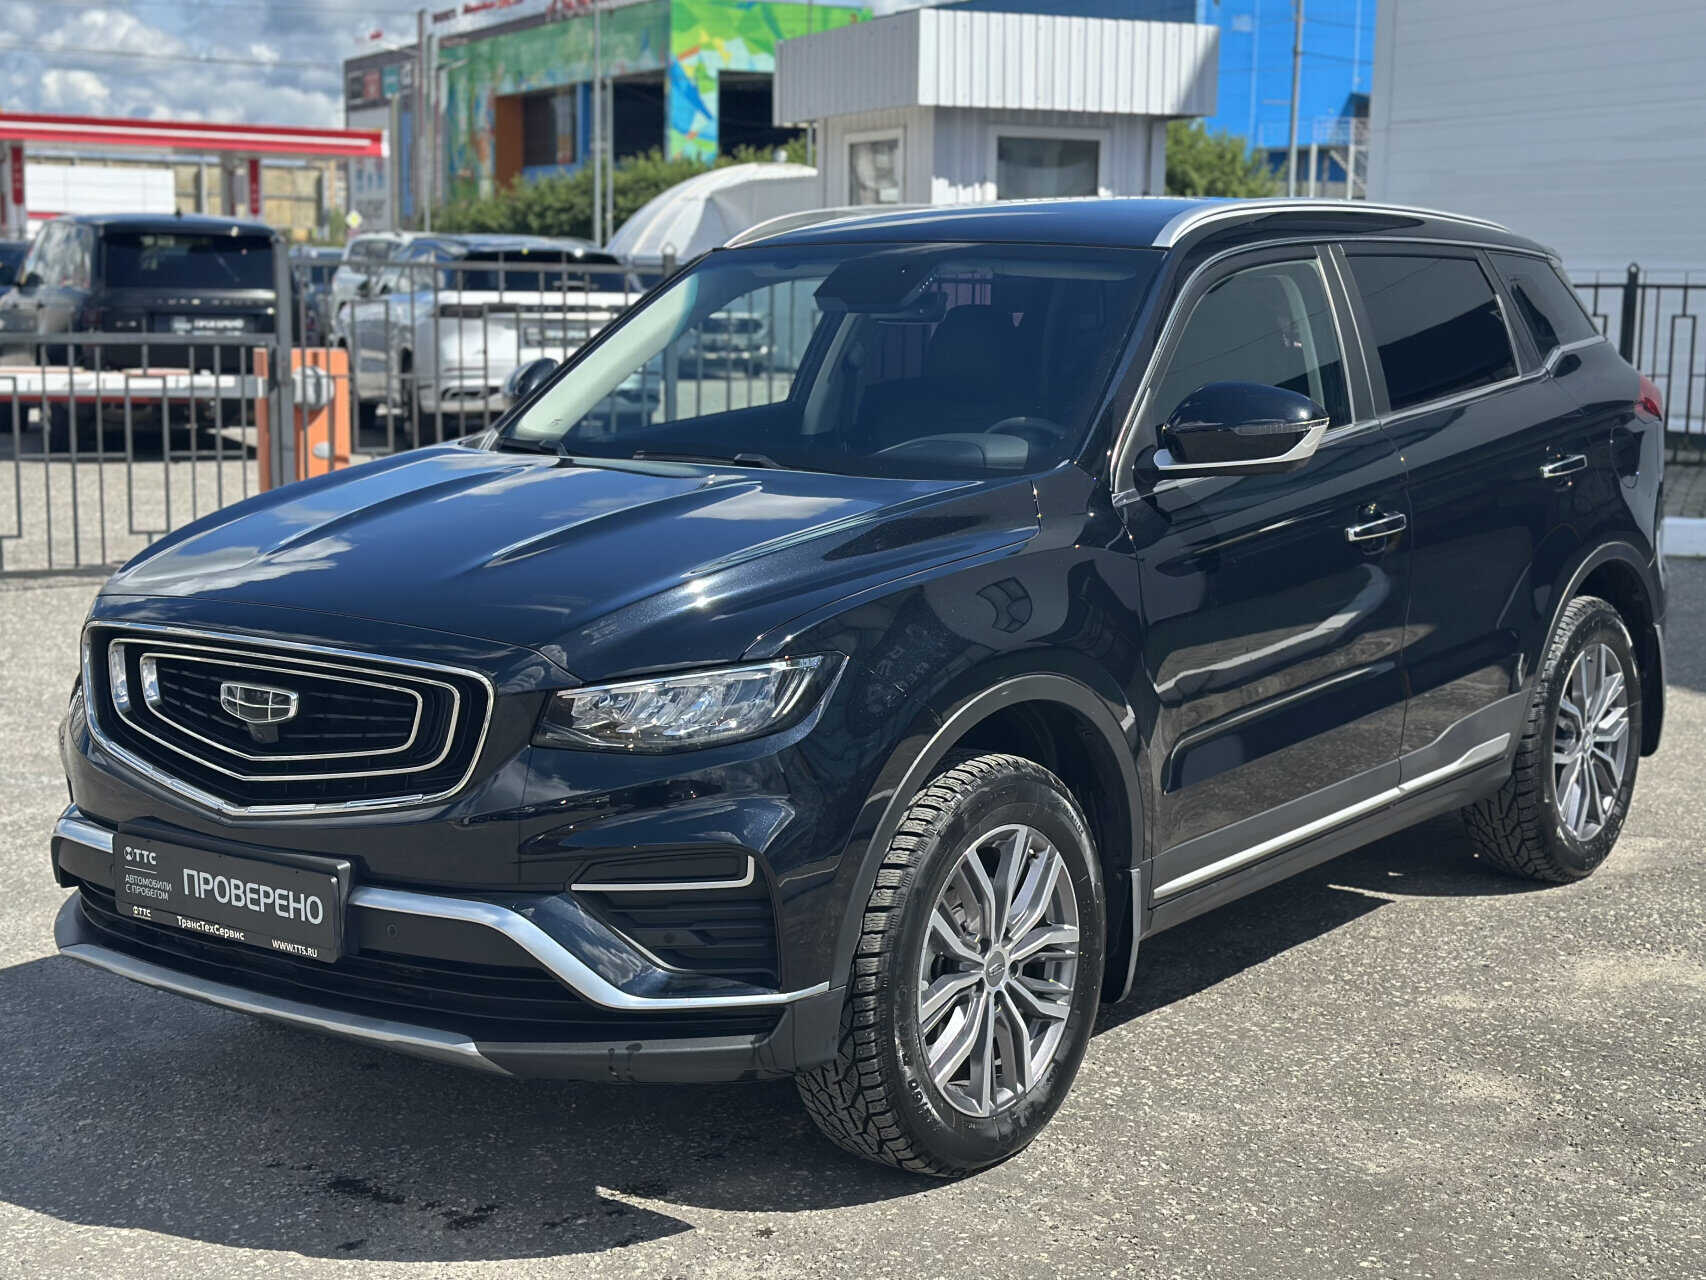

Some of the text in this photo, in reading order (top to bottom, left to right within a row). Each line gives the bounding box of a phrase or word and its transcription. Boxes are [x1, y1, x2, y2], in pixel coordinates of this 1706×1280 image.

[134, 848, 157, 865] ТТС
[125, 873, 172, 892] АВТОМОБИЛИ
[125, 884, 169, 901] С ПРОБЕГОМ
[183, 868, 324, 925] ПРОВЕРЕНО
[176, 915, 245, 941] ТрансТехСервис
[271, 938, 318, 959] WWW.TTS.RU
